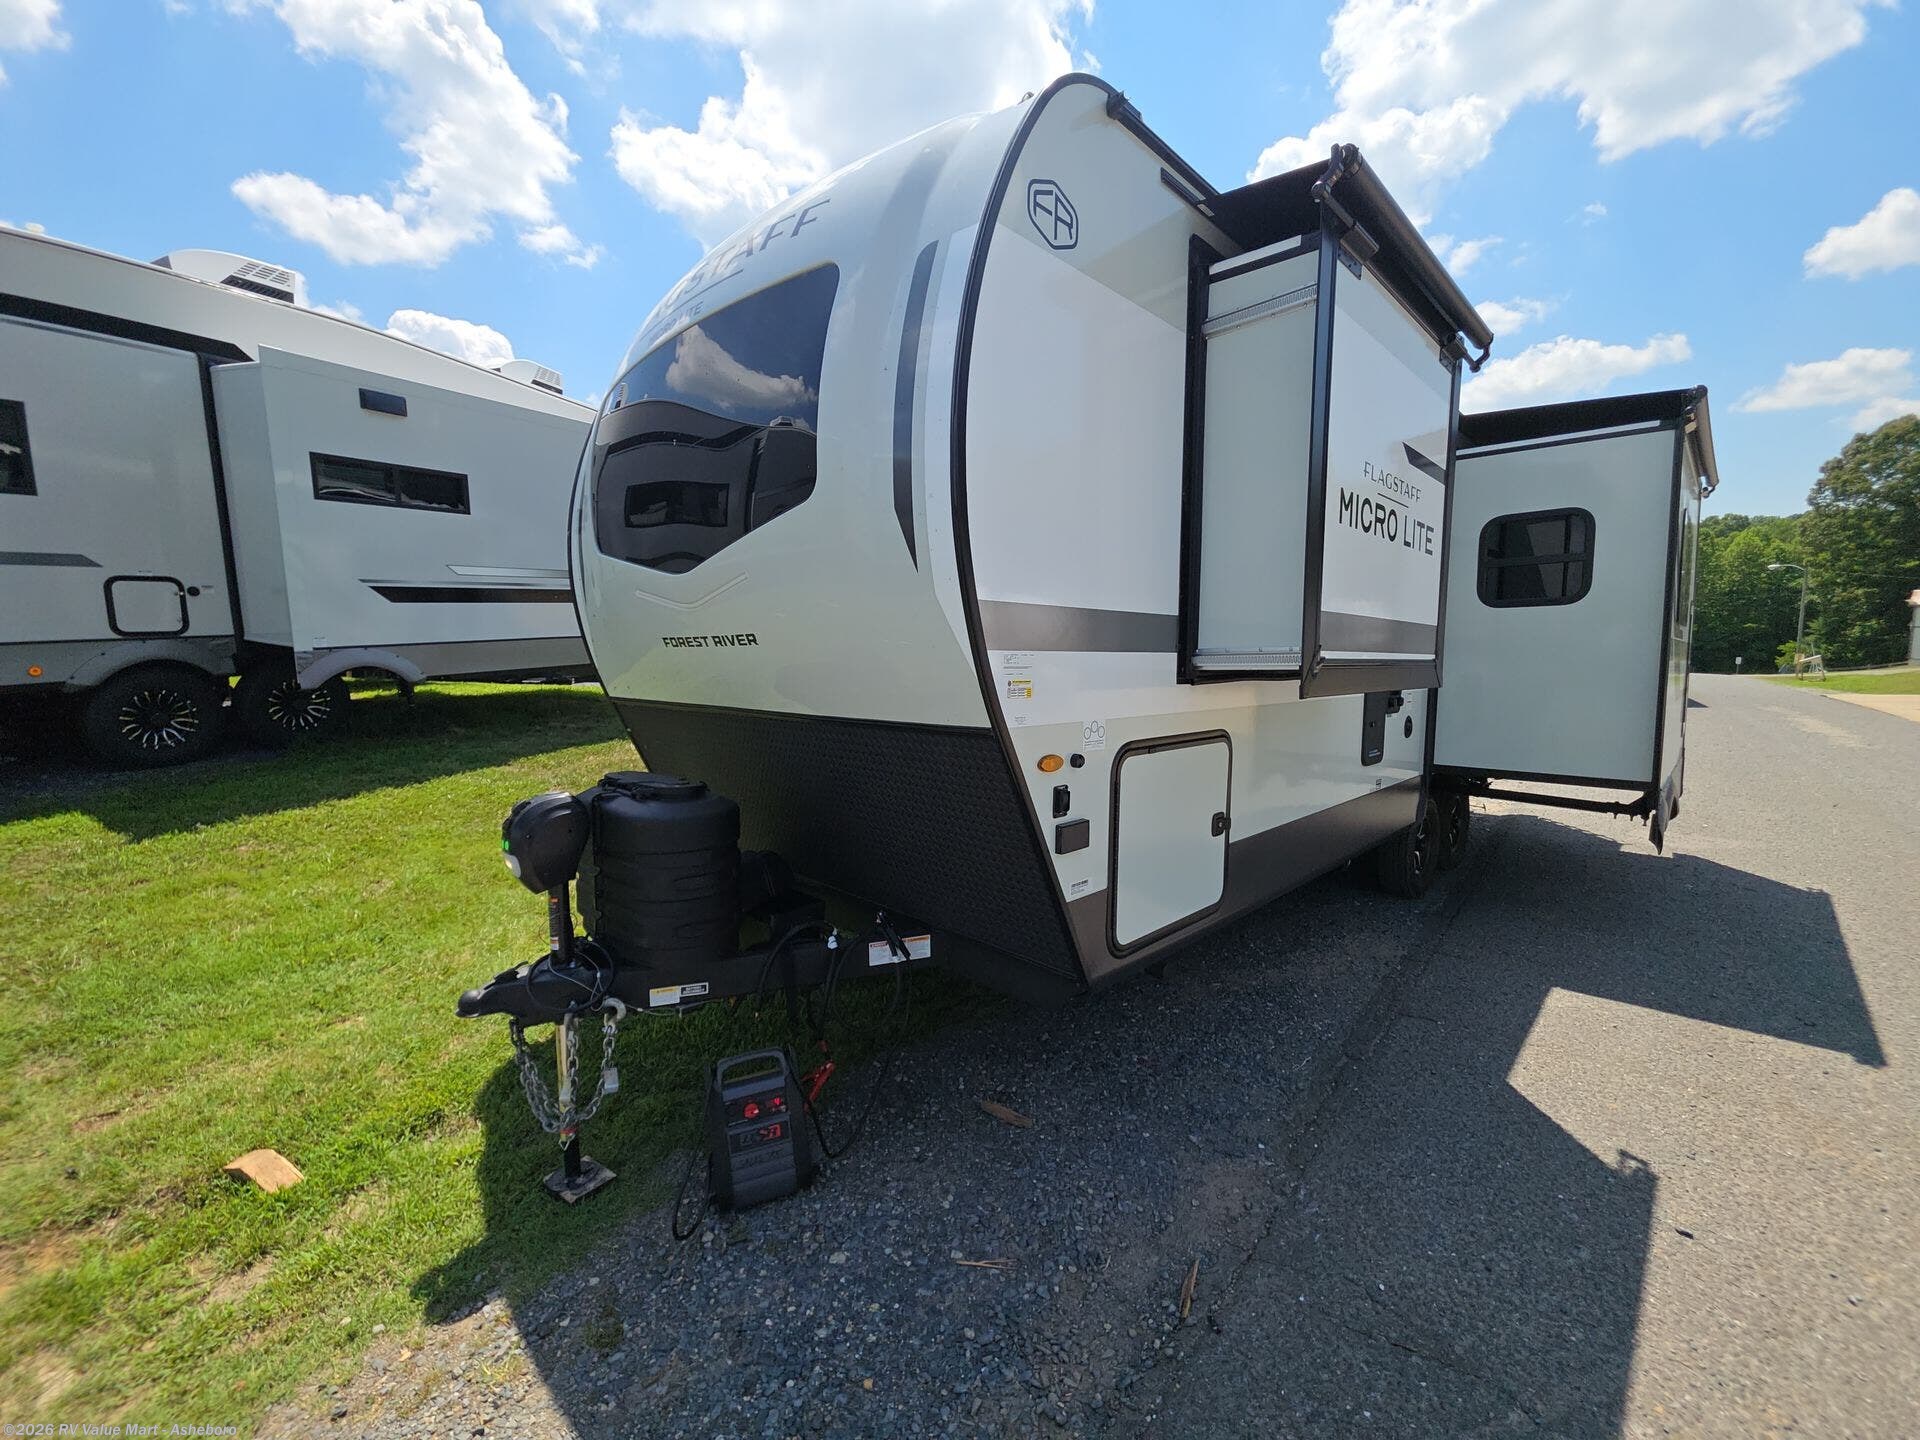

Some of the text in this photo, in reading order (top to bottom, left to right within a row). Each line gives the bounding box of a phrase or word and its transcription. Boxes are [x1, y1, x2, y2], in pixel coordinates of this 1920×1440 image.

[1363, 461, 1422, 502] FLAGSTAFF
[1339, 487, 1435, 556] MICRO LITE
[662, 633, 759, 648] FOREST RIVER
